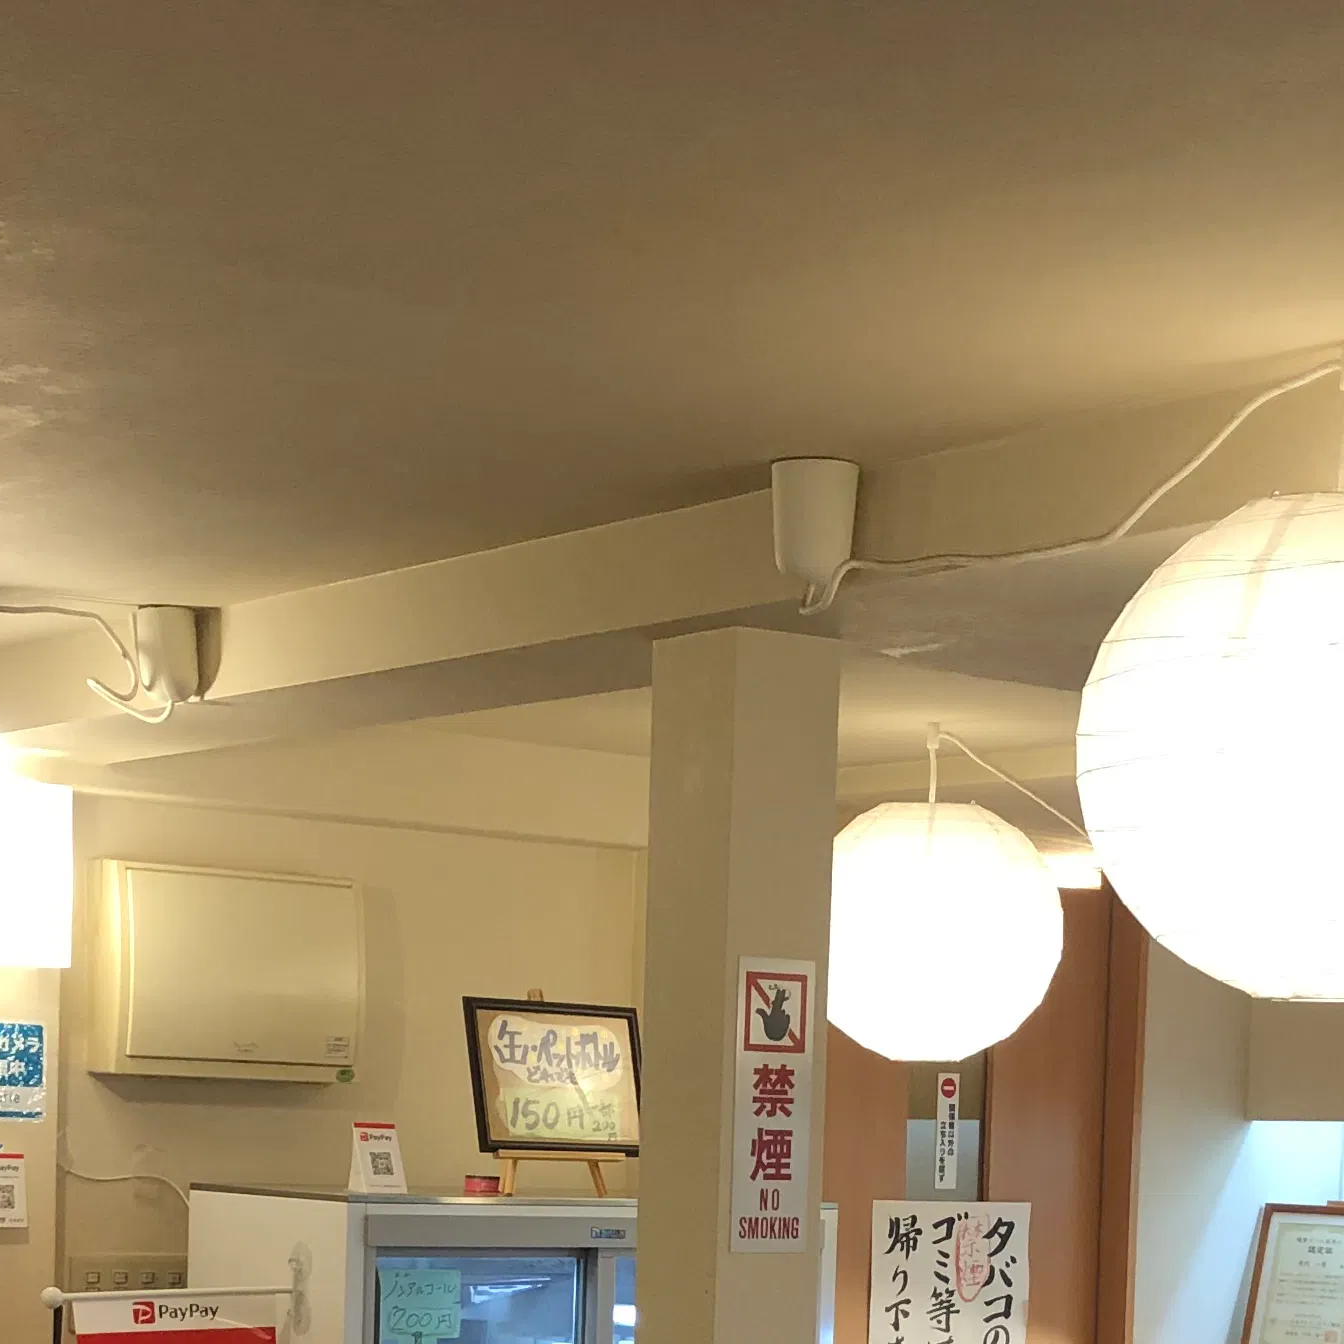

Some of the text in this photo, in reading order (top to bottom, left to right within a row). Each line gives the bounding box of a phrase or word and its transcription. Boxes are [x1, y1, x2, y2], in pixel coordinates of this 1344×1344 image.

[510, 1097, 585, 1131] 150円
[749, 1063, 795, 1182] 禁煙
[759, 1188, 780, 1211] NO
[738, 1217, 799, 1240] SMOKING
[158, 1303, 219, 1321] PayPay
[390, 1306, 452, 1332] 200円
